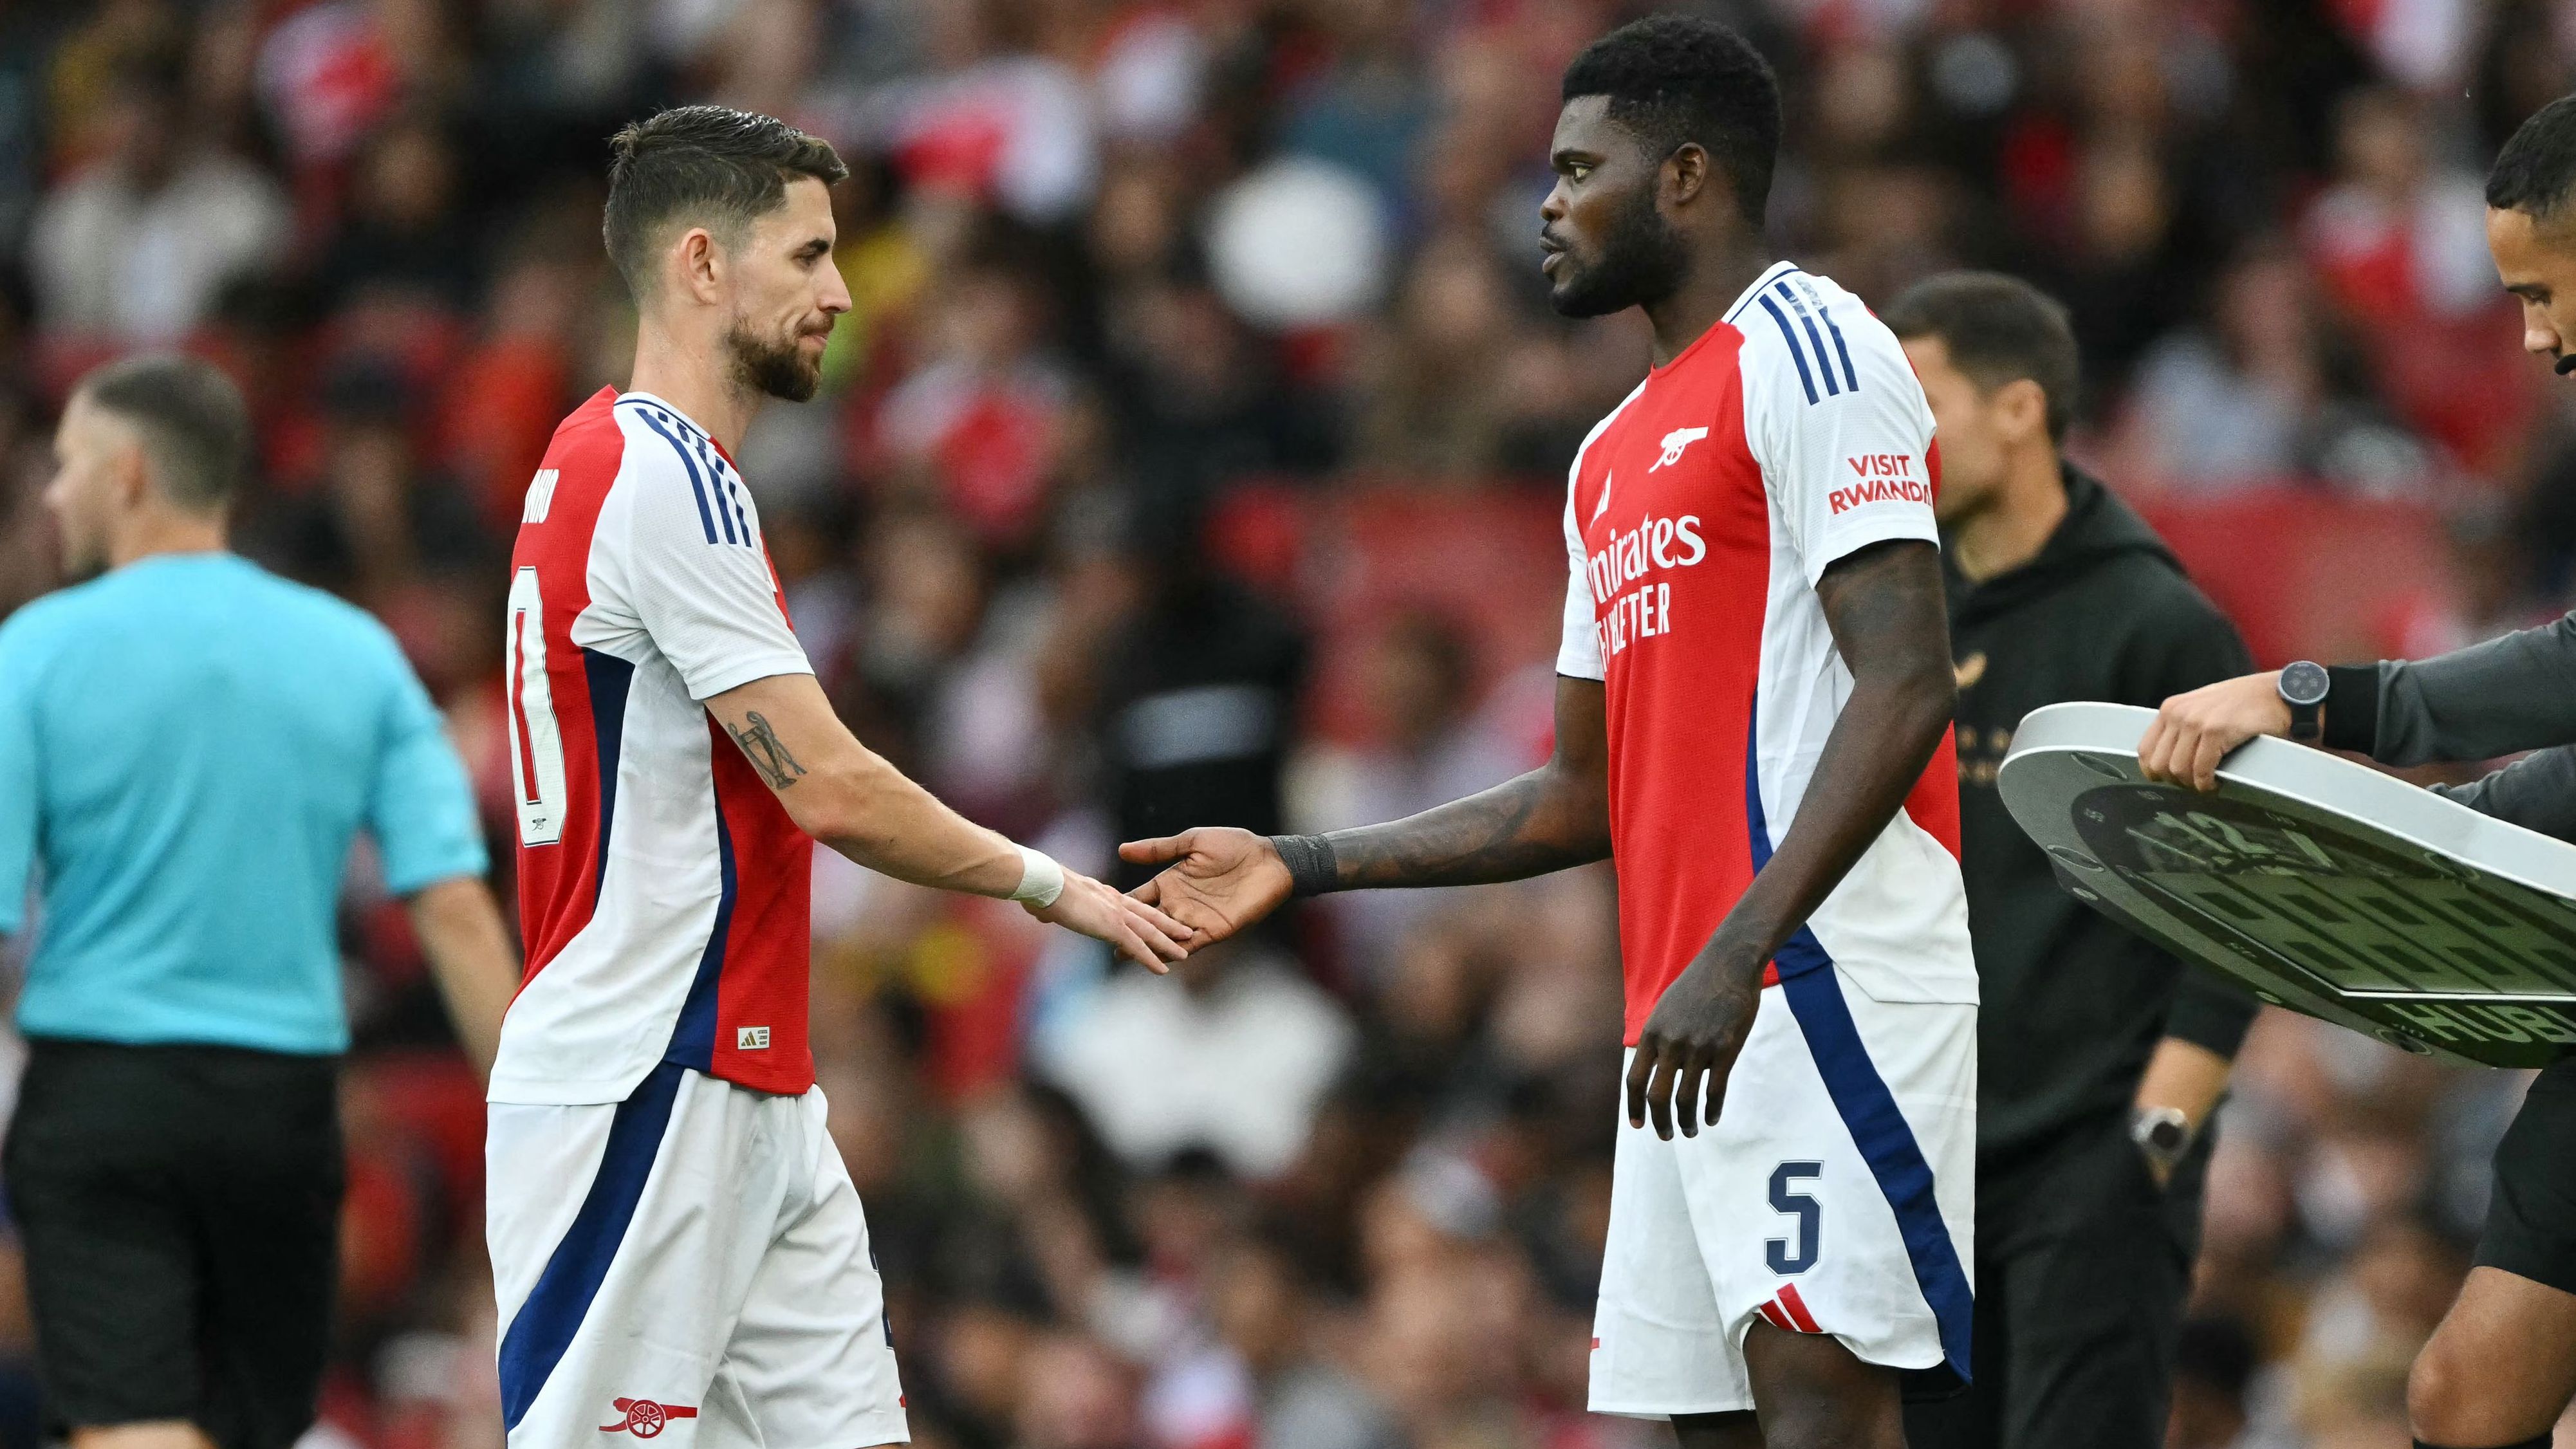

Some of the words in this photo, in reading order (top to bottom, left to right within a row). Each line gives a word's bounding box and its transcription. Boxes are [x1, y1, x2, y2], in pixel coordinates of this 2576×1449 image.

[1848, 454, 1909, 477] VISIT
[1587, 512, 1706, 604] mirates
[1763, 1159, 1824, 1277] 5
